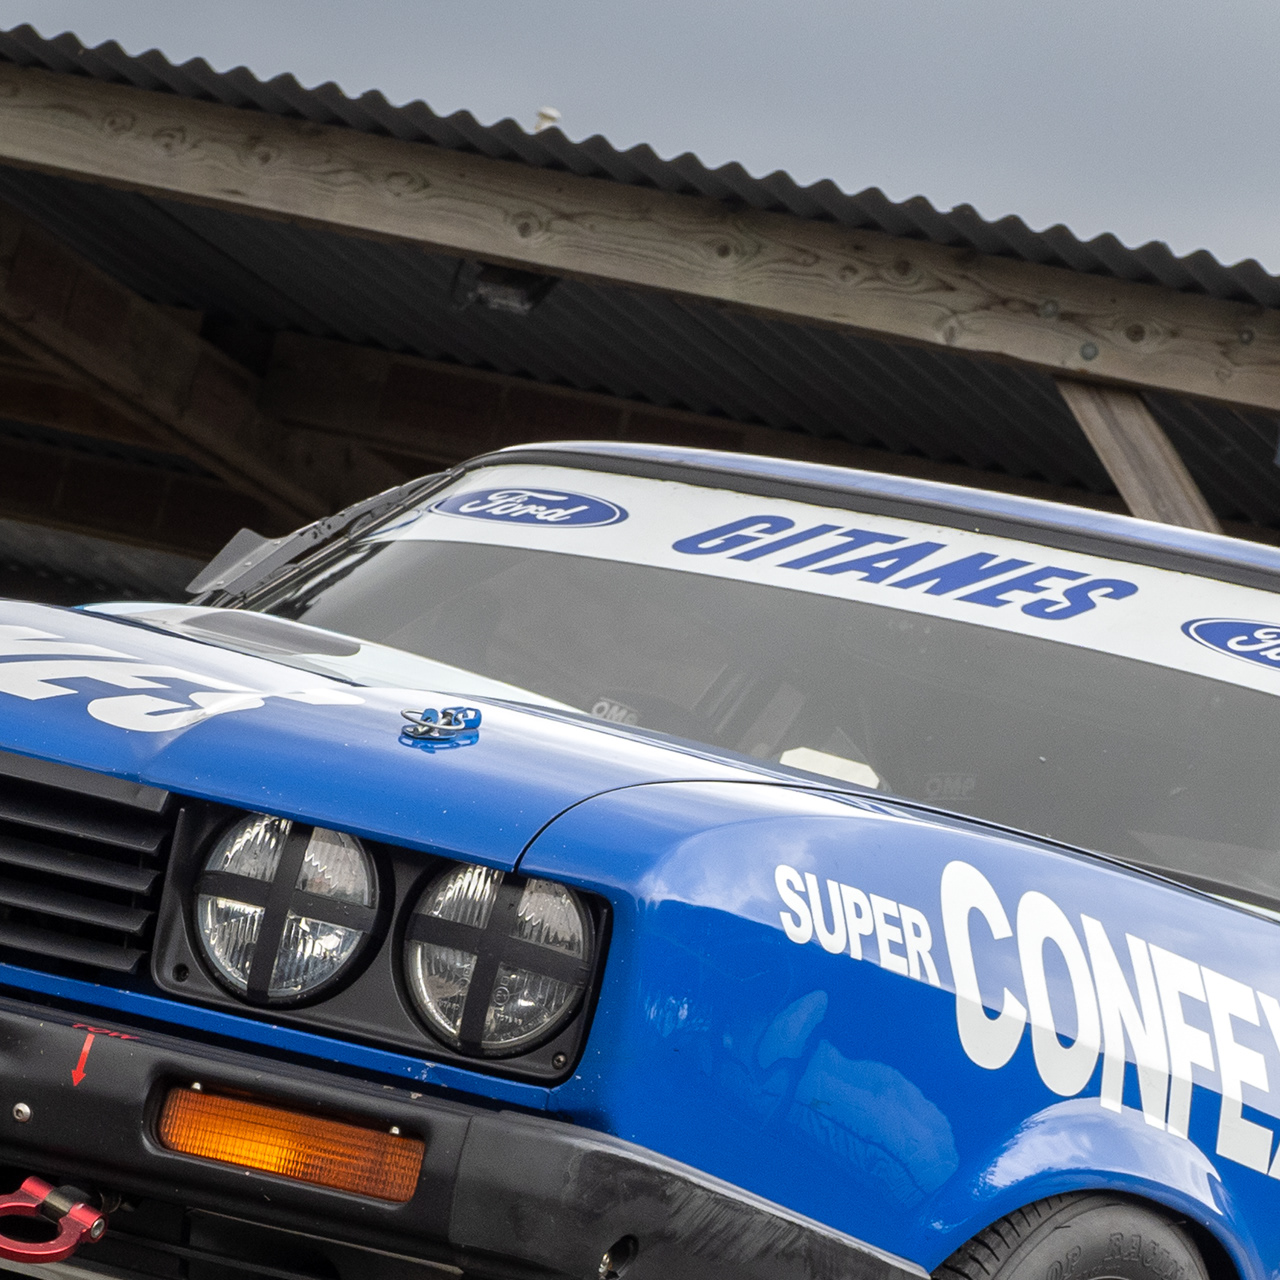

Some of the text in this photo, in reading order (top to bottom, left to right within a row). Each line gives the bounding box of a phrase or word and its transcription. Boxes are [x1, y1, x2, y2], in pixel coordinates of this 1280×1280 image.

[459, 489, 589, 522] Ford
[672, 514, 1138, 621] GITANES
[774, 864, 942, 987] SUPER
